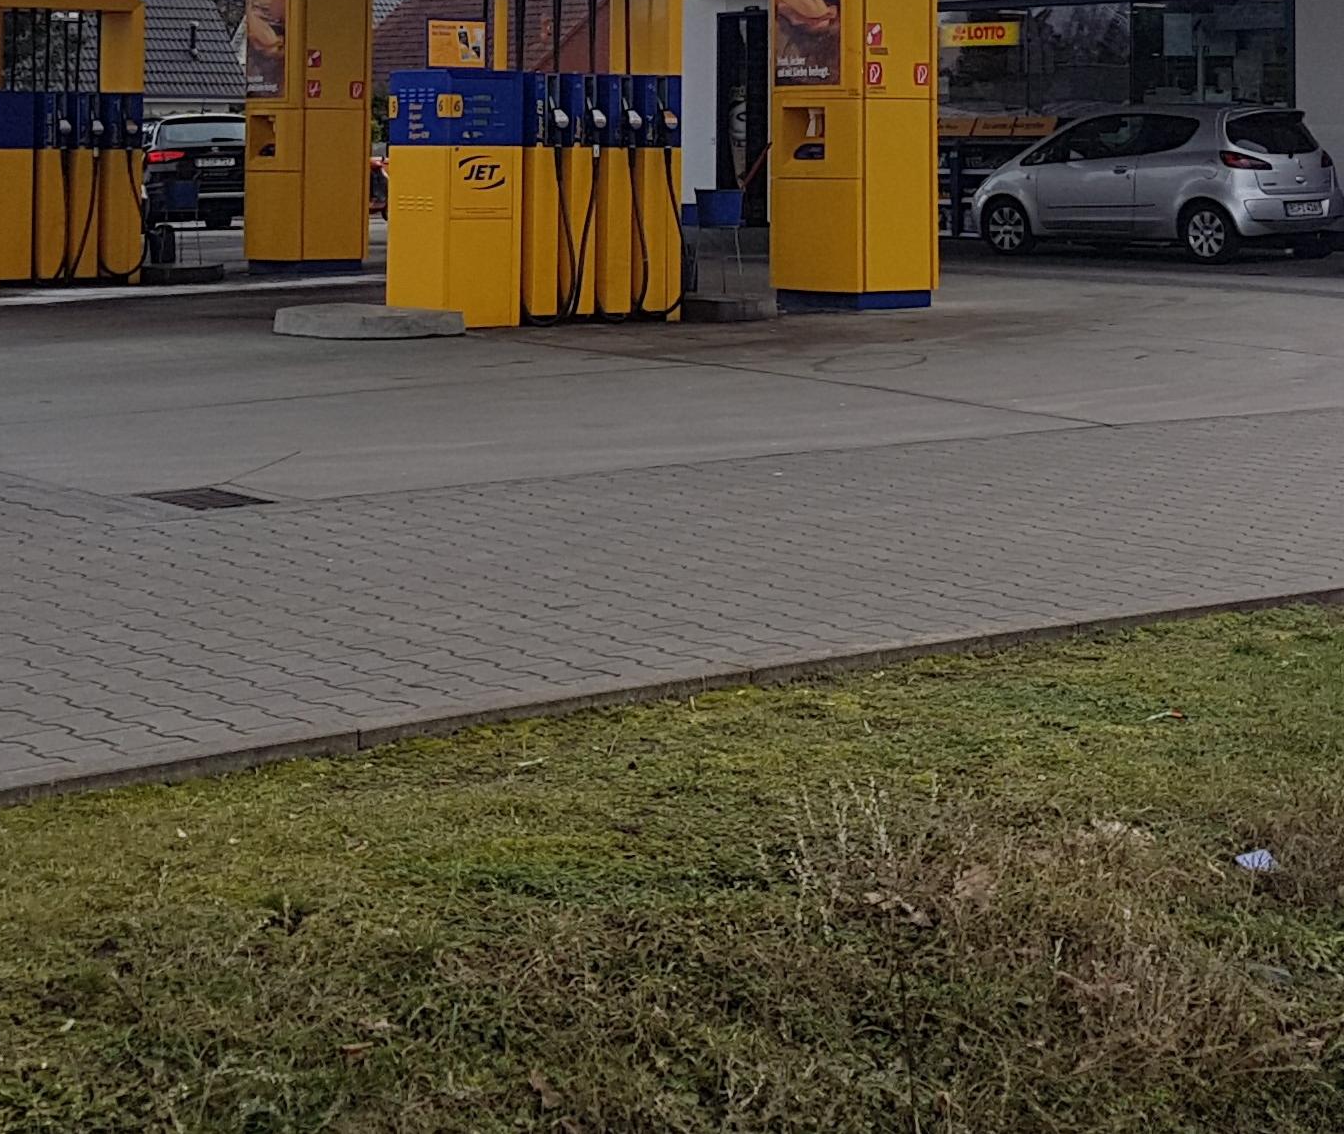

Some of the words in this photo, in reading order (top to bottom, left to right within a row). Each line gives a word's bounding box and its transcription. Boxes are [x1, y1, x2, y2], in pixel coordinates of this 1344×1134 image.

[967, 26, 1006, 41] LOTTO
[454, 100, 461, 113] 6
[463, 164, 501, 181] JET
